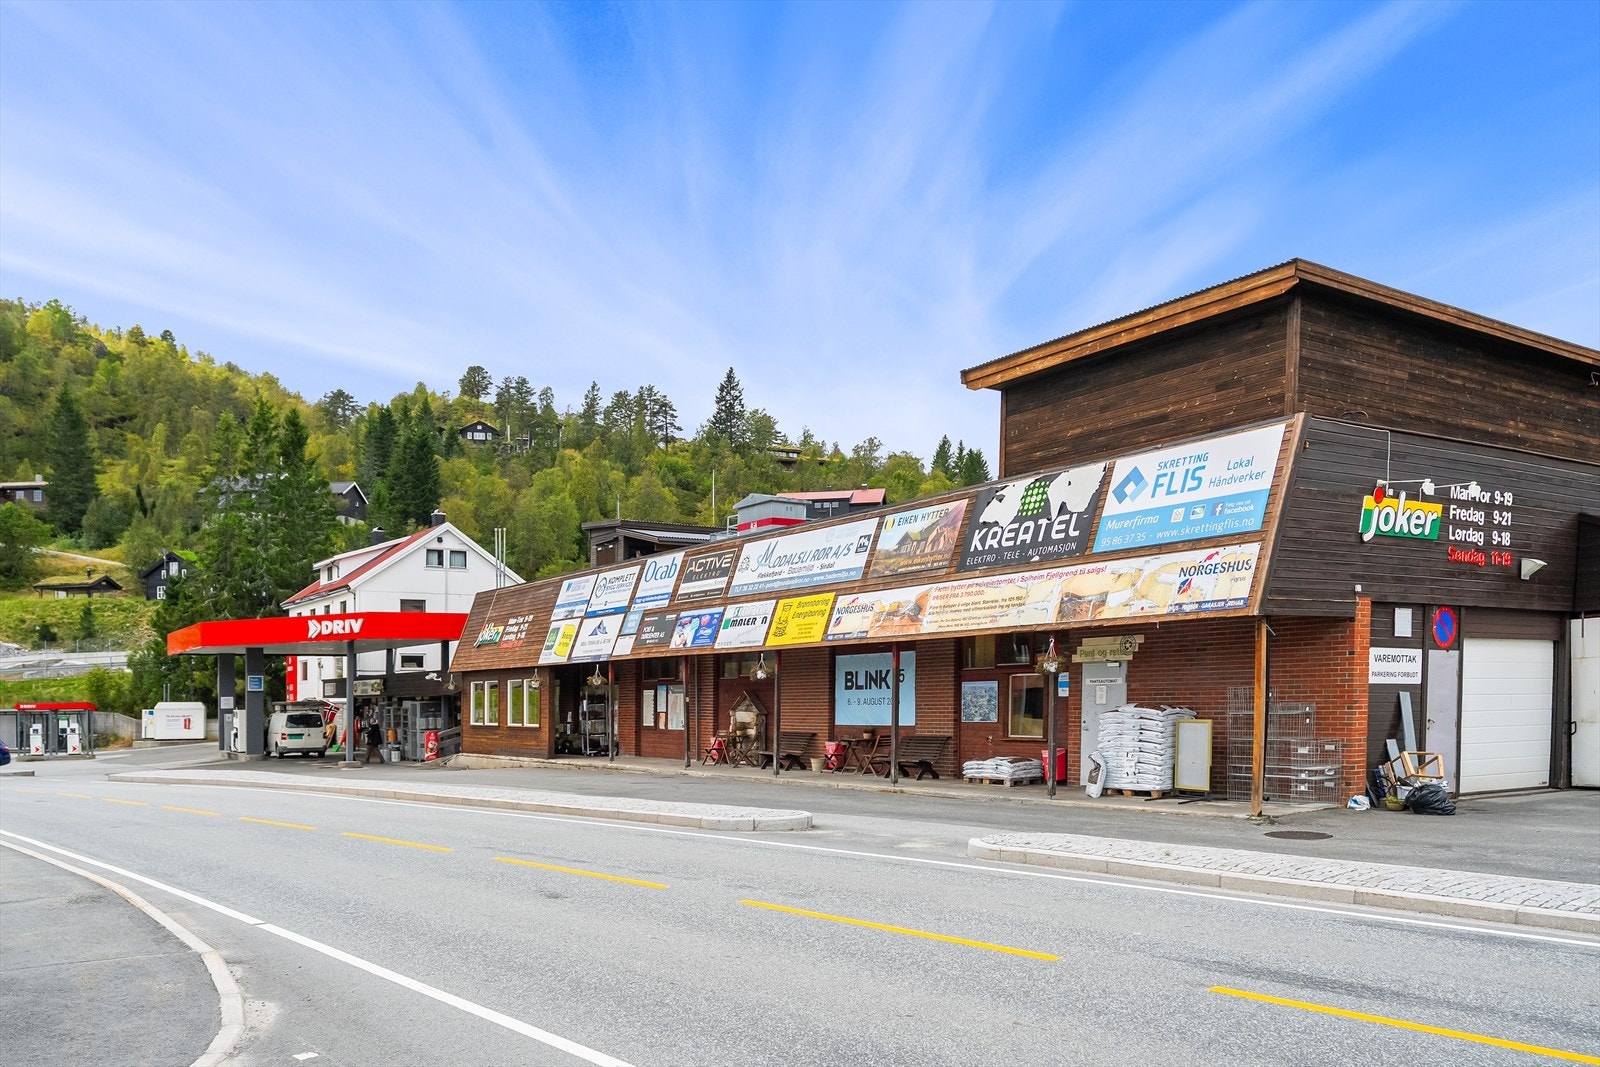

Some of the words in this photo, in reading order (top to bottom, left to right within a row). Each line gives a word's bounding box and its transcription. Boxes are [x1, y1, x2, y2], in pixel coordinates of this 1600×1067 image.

[1157, 452, 1209, 471] SKRETTING
[1226, 456, 1254, 471] Lokal
[1151, 465, 1206, 499] FLIS
[1208, 470, 1266, 488] Håndverker
[1450, 485, 1491, 503] Man-or
[1494, 490, 1513, 506] 9-19
[897, 514, 918, 526] EIKEN
[920, 507, 949, 521] HYTTER
[1224, 503, 1255, 515] facebook
[1362, 490, 1438, 542] joker
[1450, 504, 1484, 526] Fredag
[1493, 510, 1512, 526] 9-21
[970, 513, 1080, 552] KREATEL
[1105, 515, 1159, 531] Murerfirma
[1156, 517, 1255, 539] www.skrettingflis.no
[1449, 525, 1484, 546] Lørdag
[1492, 531, 1511, 546] 9-18
[686, 553, 734, 574] ACTIVE
[966, 554, 996, 566] ELEKTRO
[1003, 550, 1020, 560] TELE
[1027, 542, 1078, 557] AUTOMASJON
[1448, 545, 1486, 568] Søndag
[644, 556, 678, 583] Ocab
[1020, 573, 1045, 582] Solheim
[1087, 565, 1108, 575] salgs!
[1179, 558, 1252, 578] NORGESHUS
[608, 572, 637, 585] KOMPLETT
[835, 602, 875, 616] NORGESHUS
[321, 618, 364, 636] DRIV
[1097, 649, 1108, 659] og
[1373, 654, 1417, 663] VAREMOTTAK
[844, 669, 891, 690] BLINK
[847, 697, 853, 706] 6.
[857, 697, 862, 706] 9.
[863, 697, 885, 706] AUGUST
